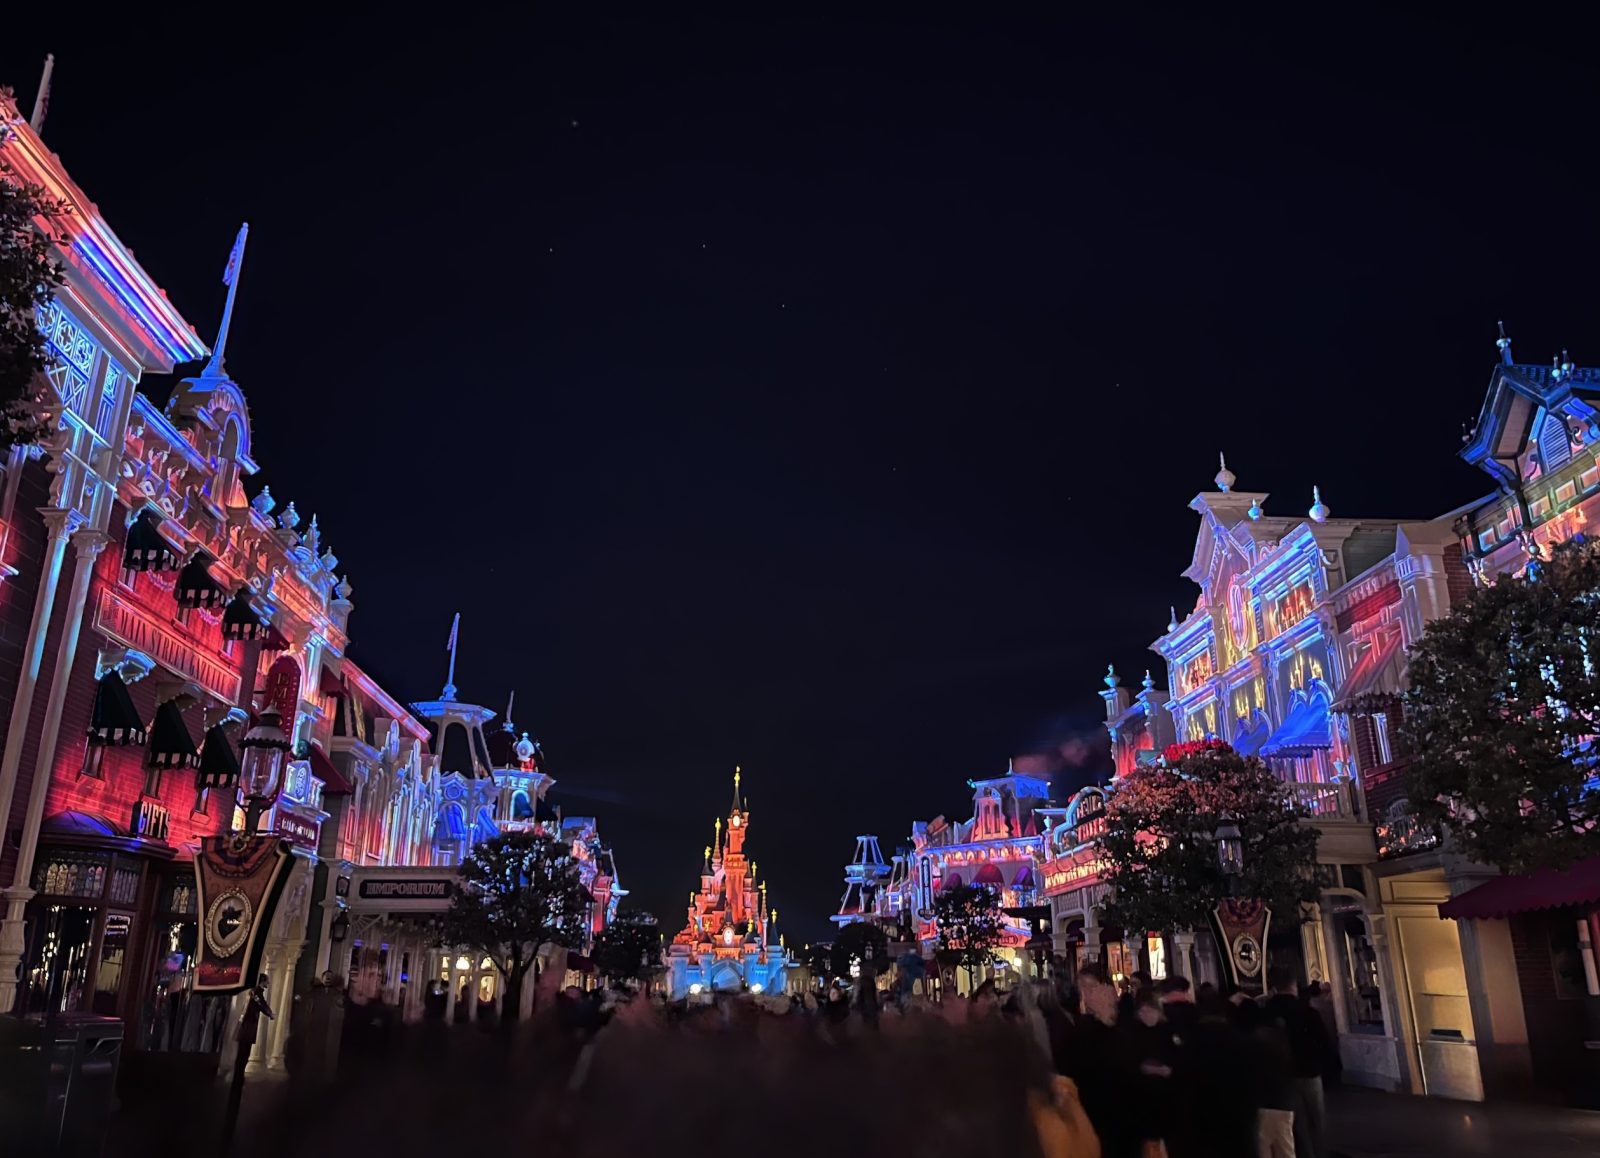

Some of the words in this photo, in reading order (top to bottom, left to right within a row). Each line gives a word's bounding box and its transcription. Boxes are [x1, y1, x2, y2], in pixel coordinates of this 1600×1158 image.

[119, 608, 147, 648] MAIN
[150, 628, 188, 672] STREET
[137, 801, 170, 840] GIFTS
[366, 882, 446, 896] EMPORIUM
